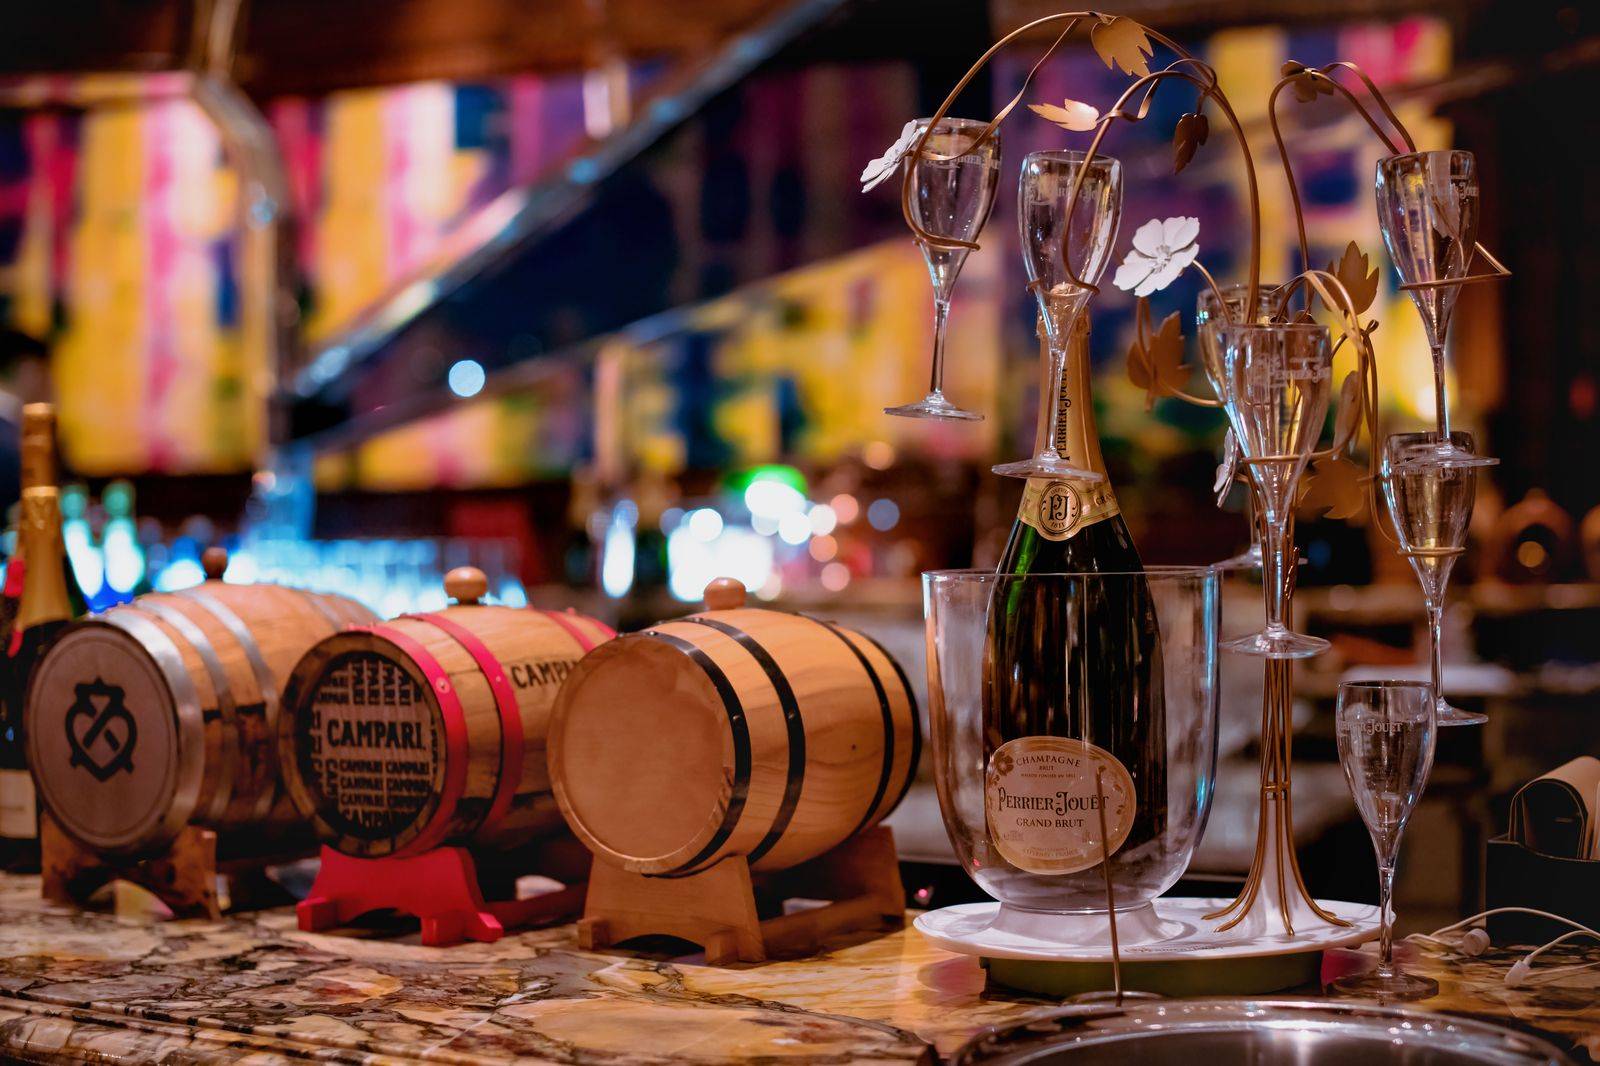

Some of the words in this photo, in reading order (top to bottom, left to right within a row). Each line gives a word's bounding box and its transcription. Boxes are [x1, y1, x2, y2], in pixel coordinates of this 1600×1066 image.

[1016, 755, 1081, 768] CHAMPAGNE
[1016, 817, 1052, 828] GRAND
[1055, 818, 1084, 829] BRUT
